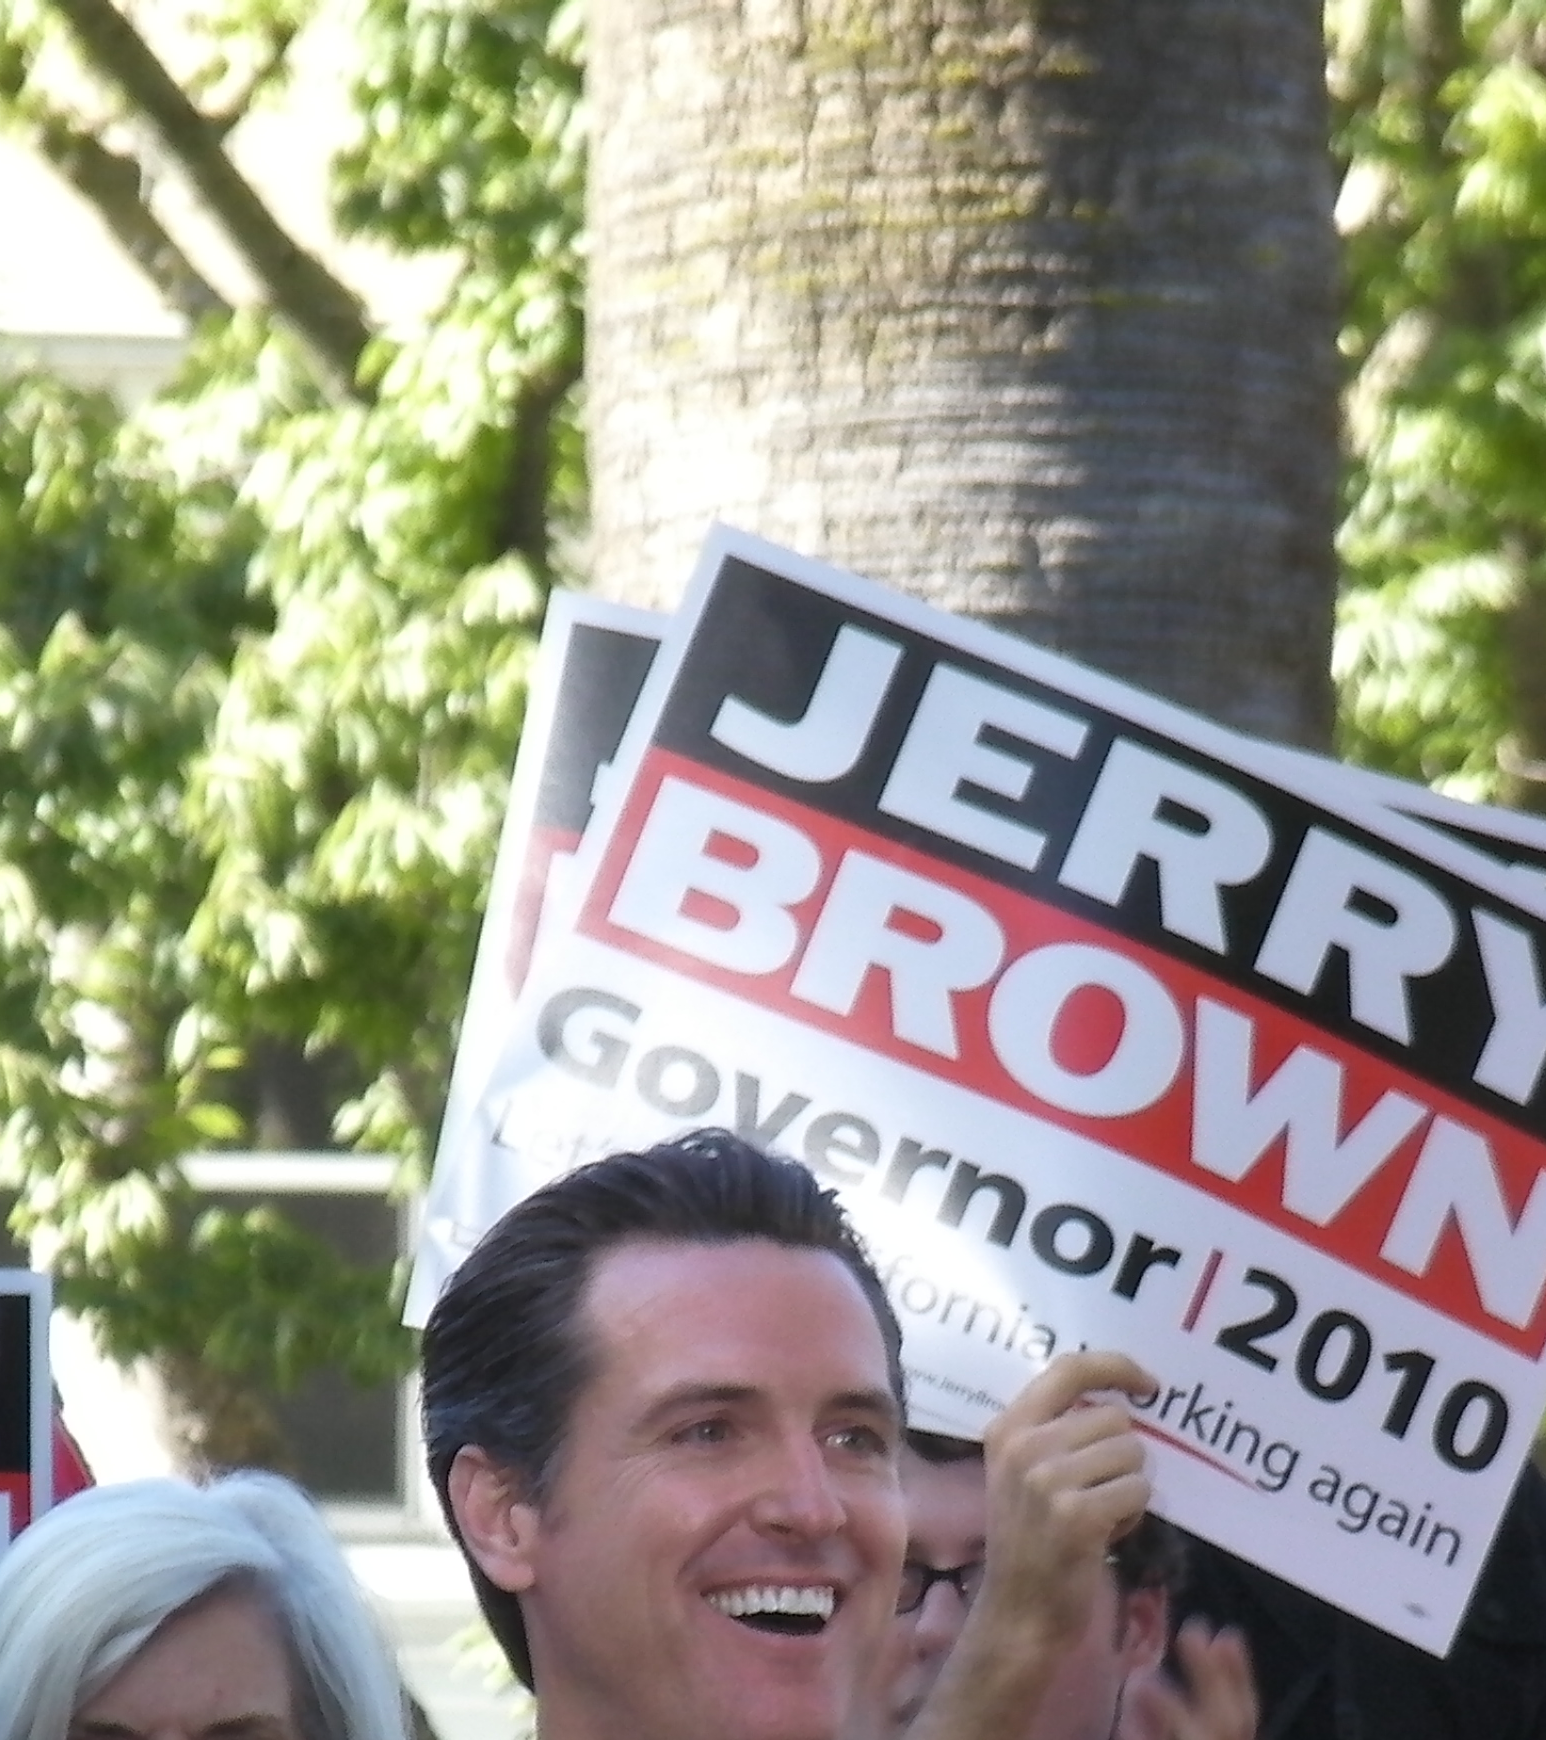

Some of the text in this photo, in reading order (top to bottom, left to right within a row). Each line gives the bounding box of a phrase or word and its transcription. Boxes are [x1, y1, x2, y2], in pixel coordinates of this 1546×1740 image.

[535, 986, 1510, 1475] Governor 2010
[883, 1252, 1058, 1363] fornia
[1125, 1380, 1300, 1496] orking
[1307, 1458, 1463, 1567] again
